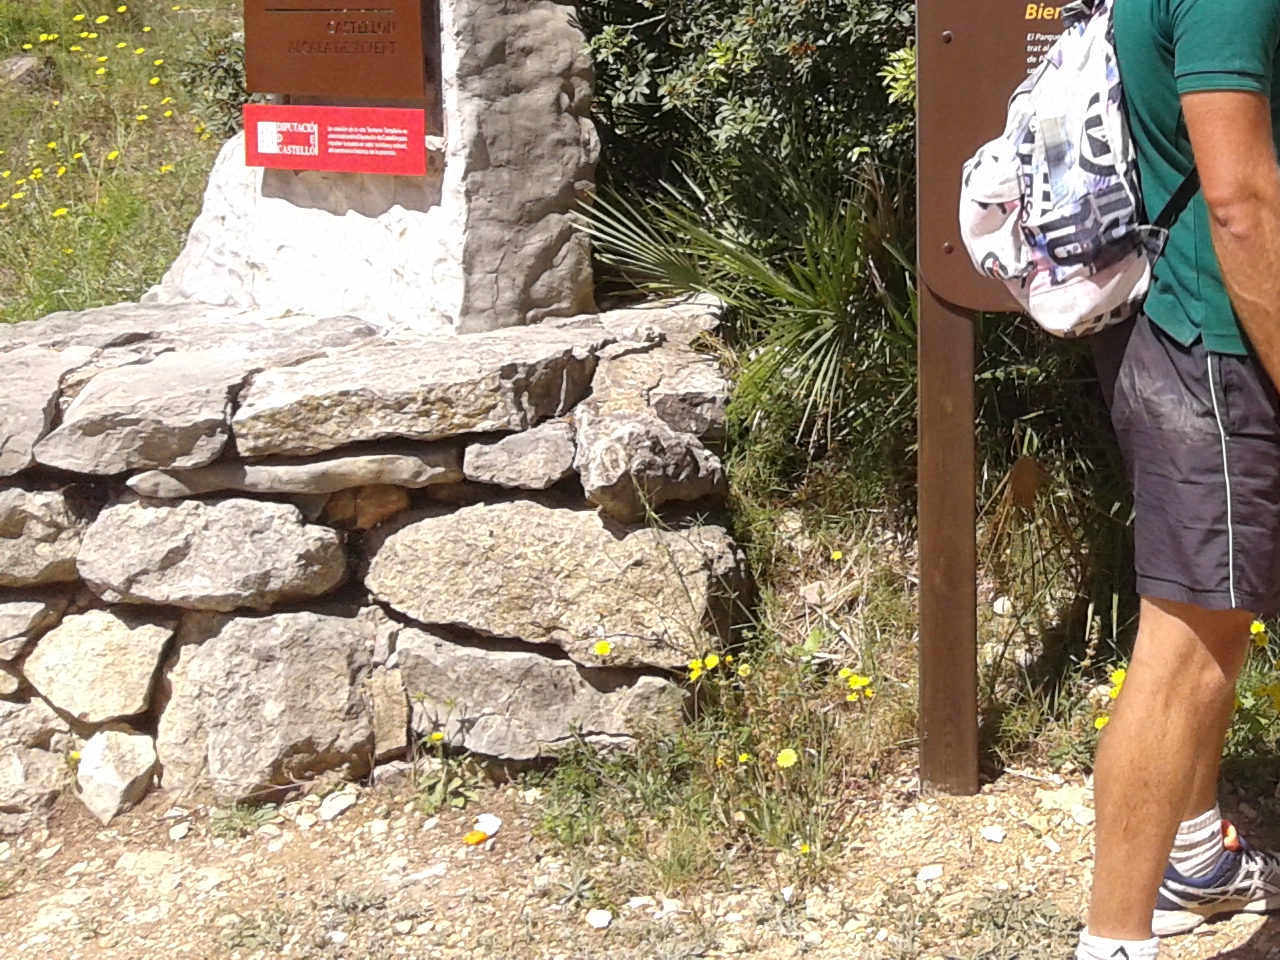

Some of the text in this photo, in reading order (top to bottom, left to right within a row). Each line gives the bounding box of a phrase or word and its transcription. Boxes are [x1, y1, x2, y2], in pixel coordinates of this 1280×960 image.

[1027, 44, 1042, 52] trat
[1027, 55, 1036, 63] de
[276, 121, 315, 133] DIPUTACIÓ
[277, 144, 316, 156] CASTELLÓ
